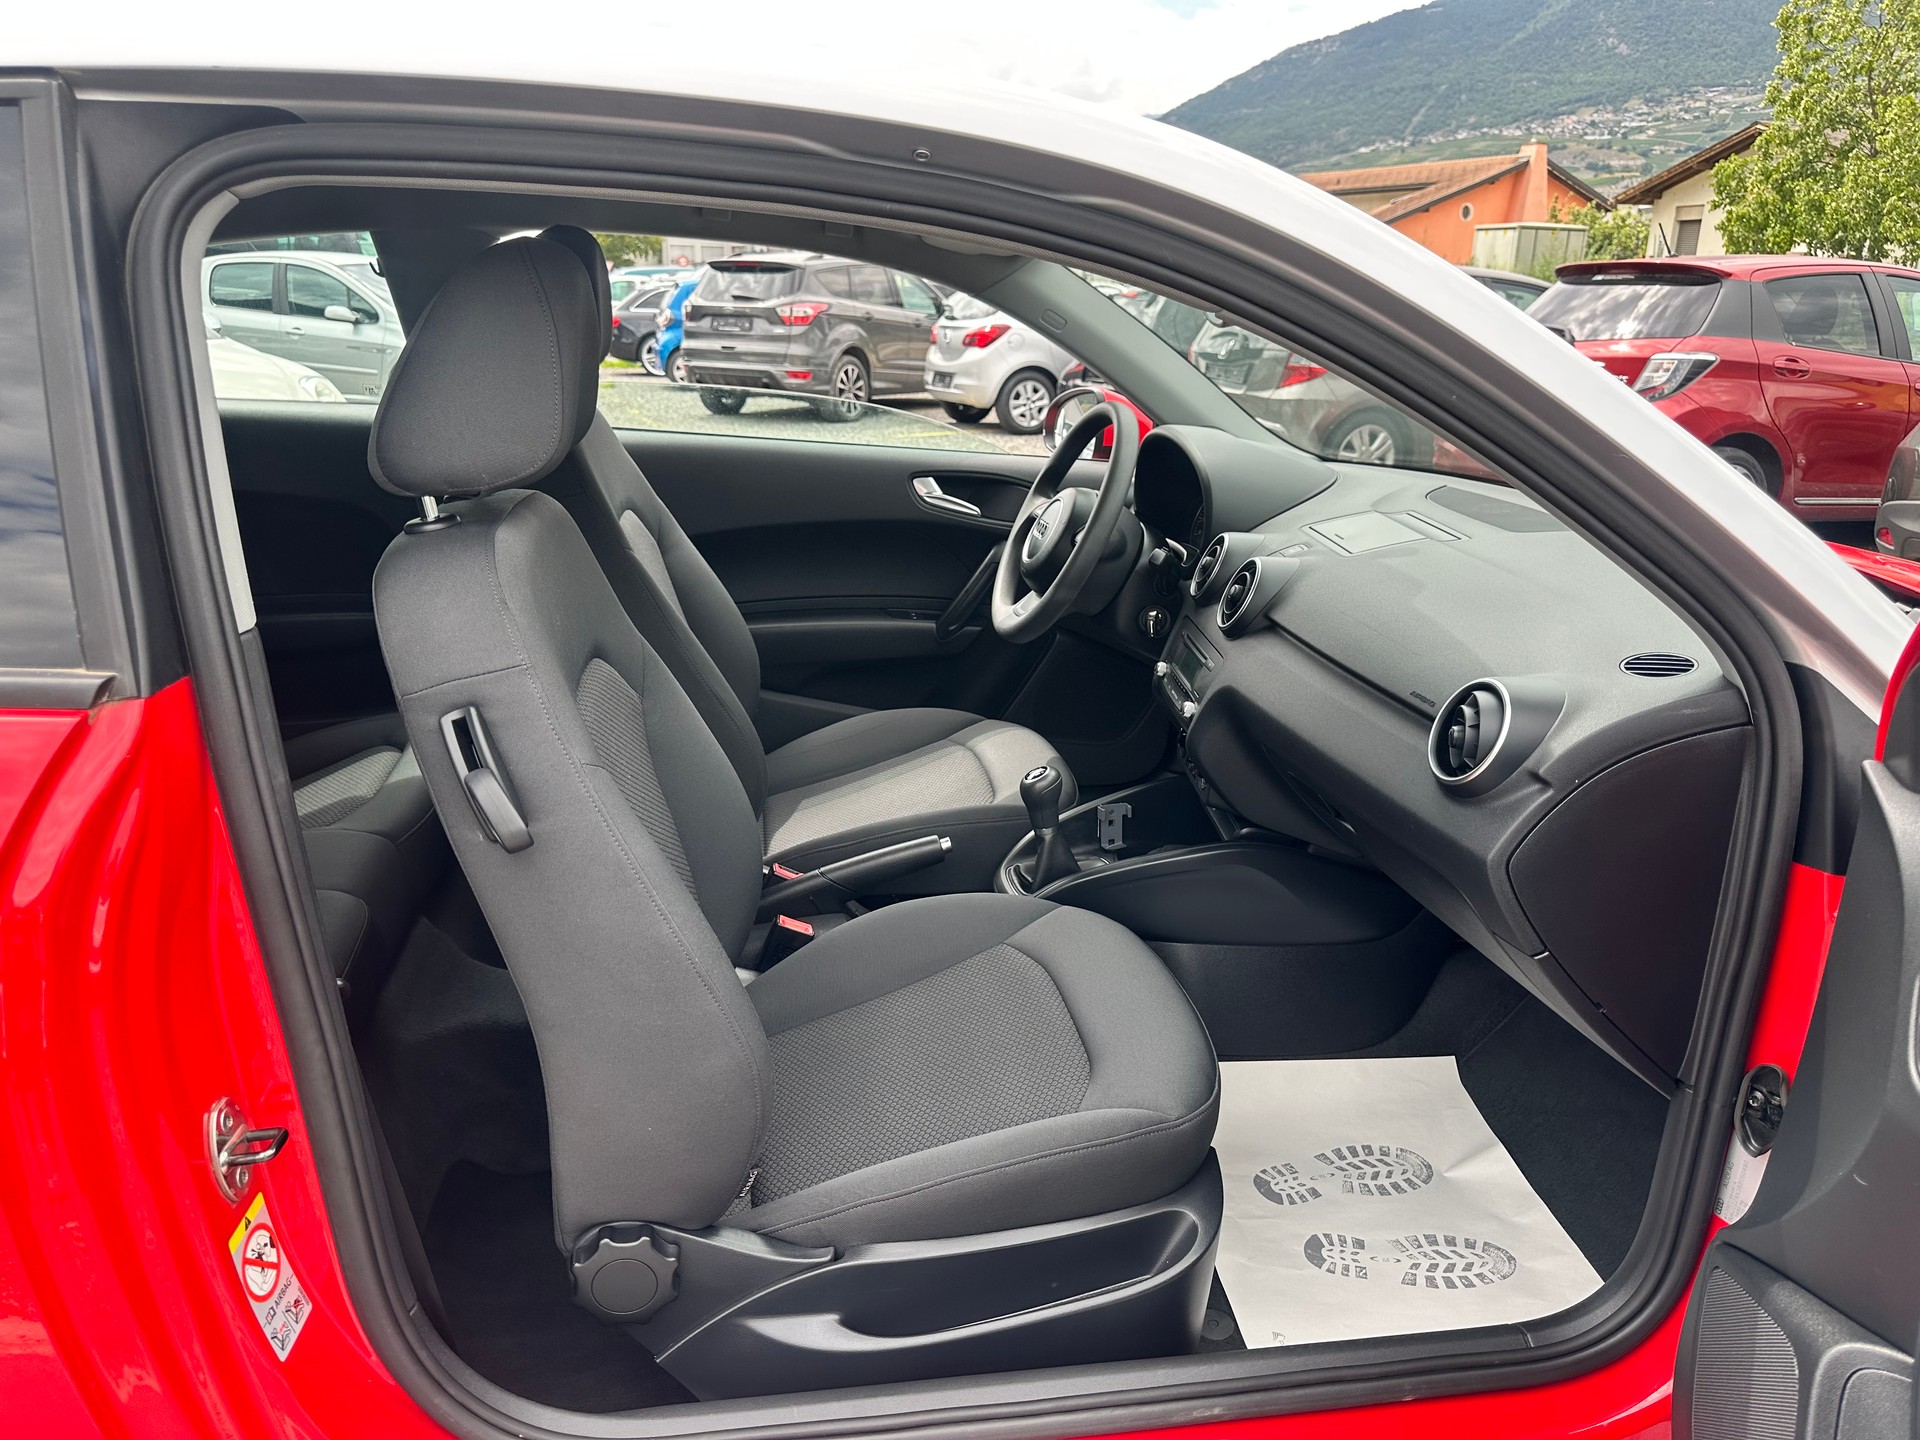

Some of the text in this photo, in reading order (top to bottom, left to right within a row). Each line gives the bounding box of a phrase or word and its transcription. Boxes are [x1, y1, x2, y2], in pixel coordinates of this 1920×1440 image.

[1723, 1171, 1731, 1189] AUDI
[1727, 1161, 1735, 1172] AG
[274, 1277, 292, 1309] AIRBAG
